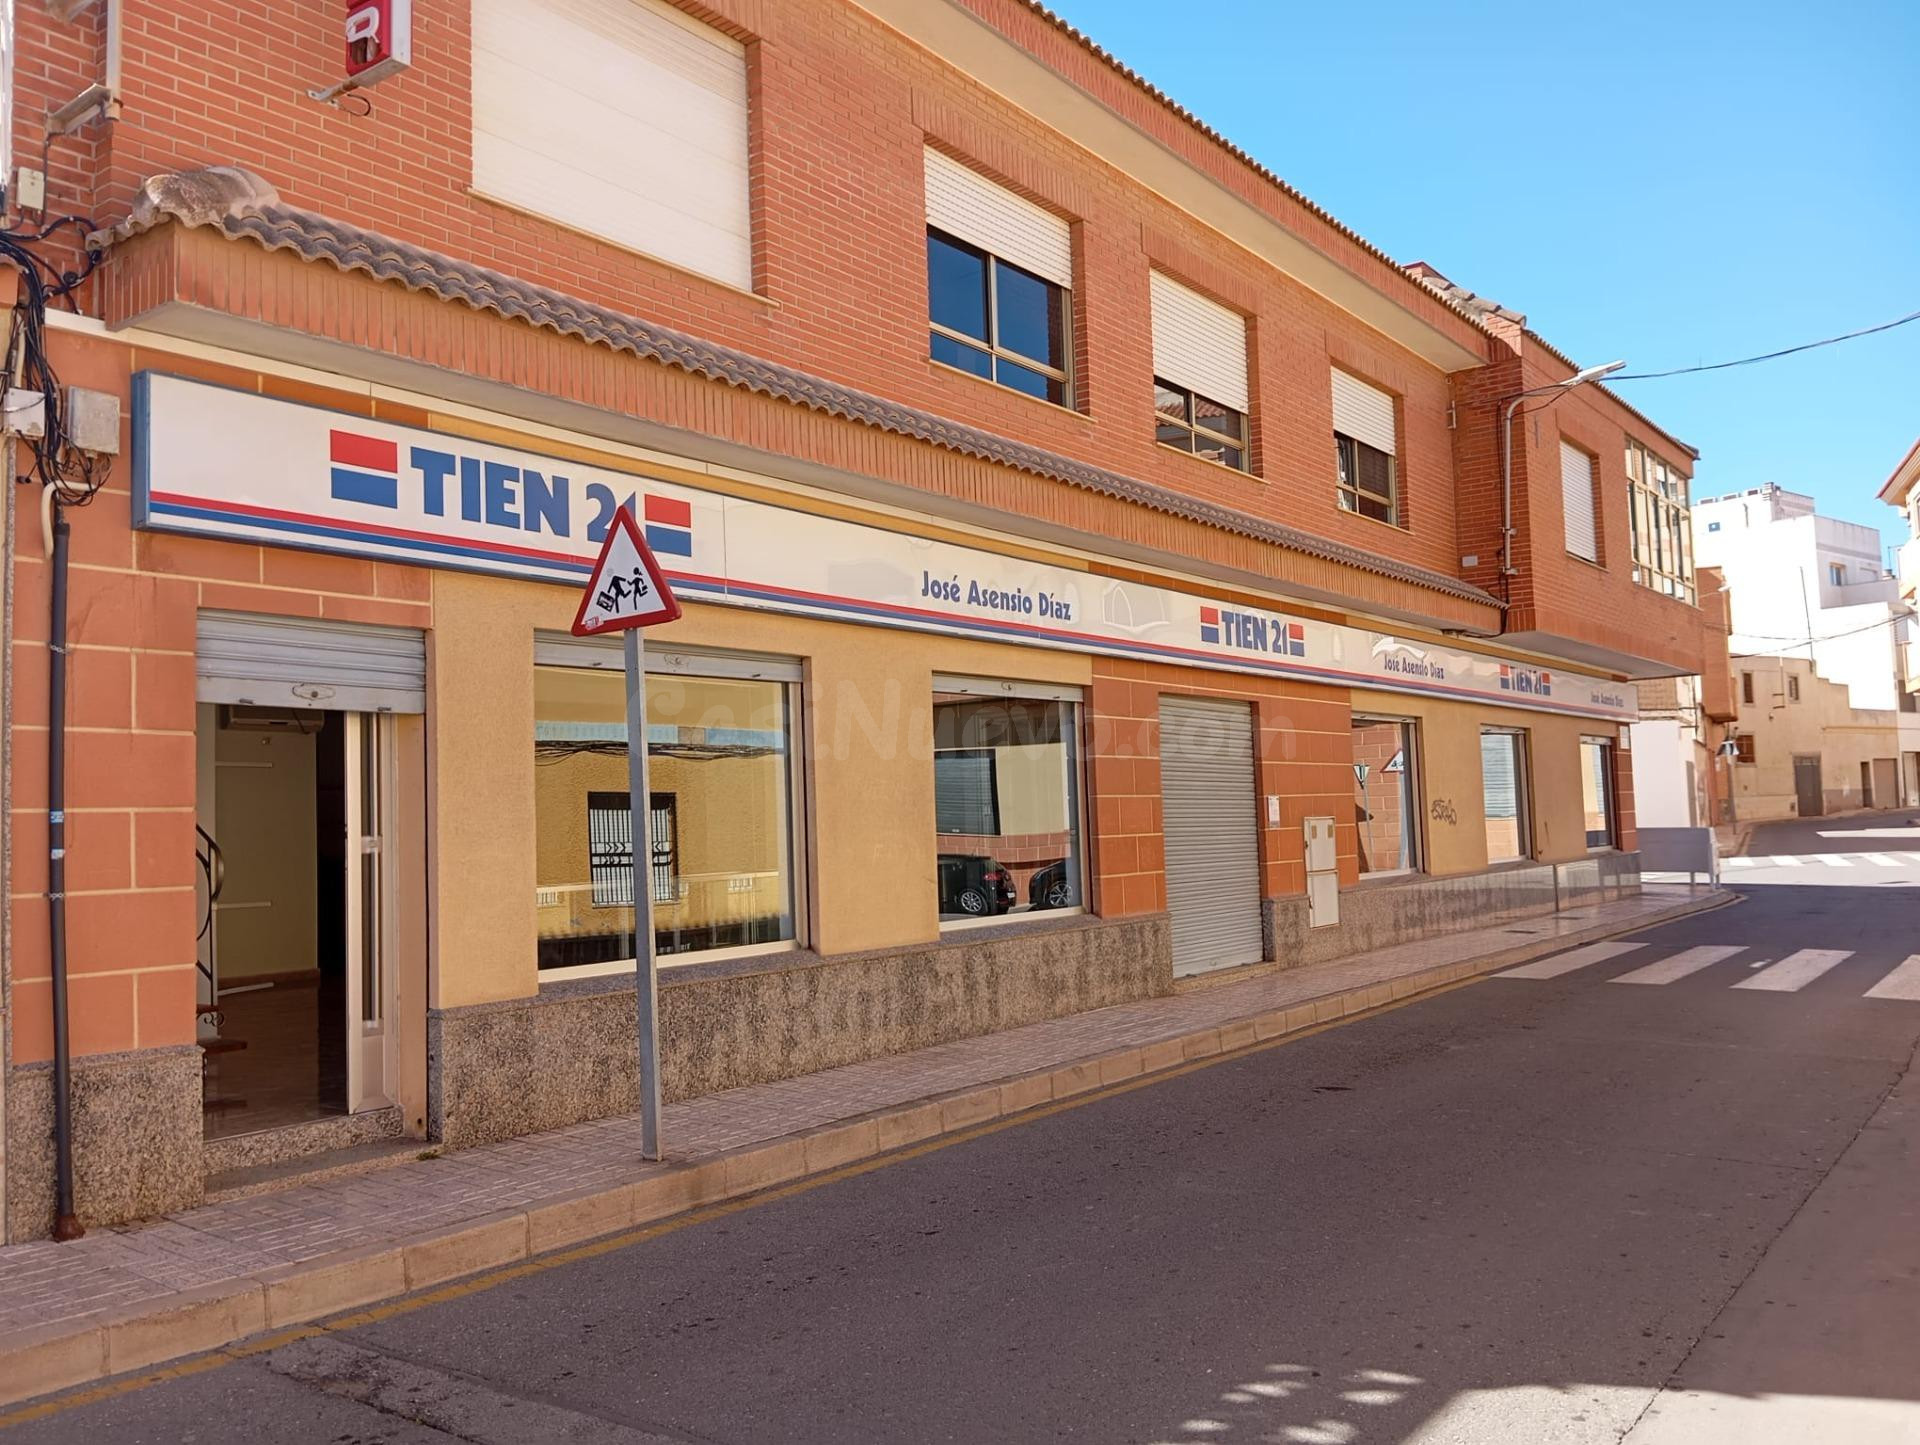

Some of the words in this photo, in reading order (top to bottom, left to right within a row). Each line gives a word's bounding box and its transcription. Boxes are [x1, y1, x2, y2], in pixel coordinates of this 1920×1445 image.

[410, 446, 570, 538] TIEN
[922, 570, 960, 602] José
[967, 580, 1033, 614] Asensio
[1039, 592, 1071, 621] Díaz
[1221, 610, 1268, 652] TIEN
[1271, 619, 1288, 655] 21
